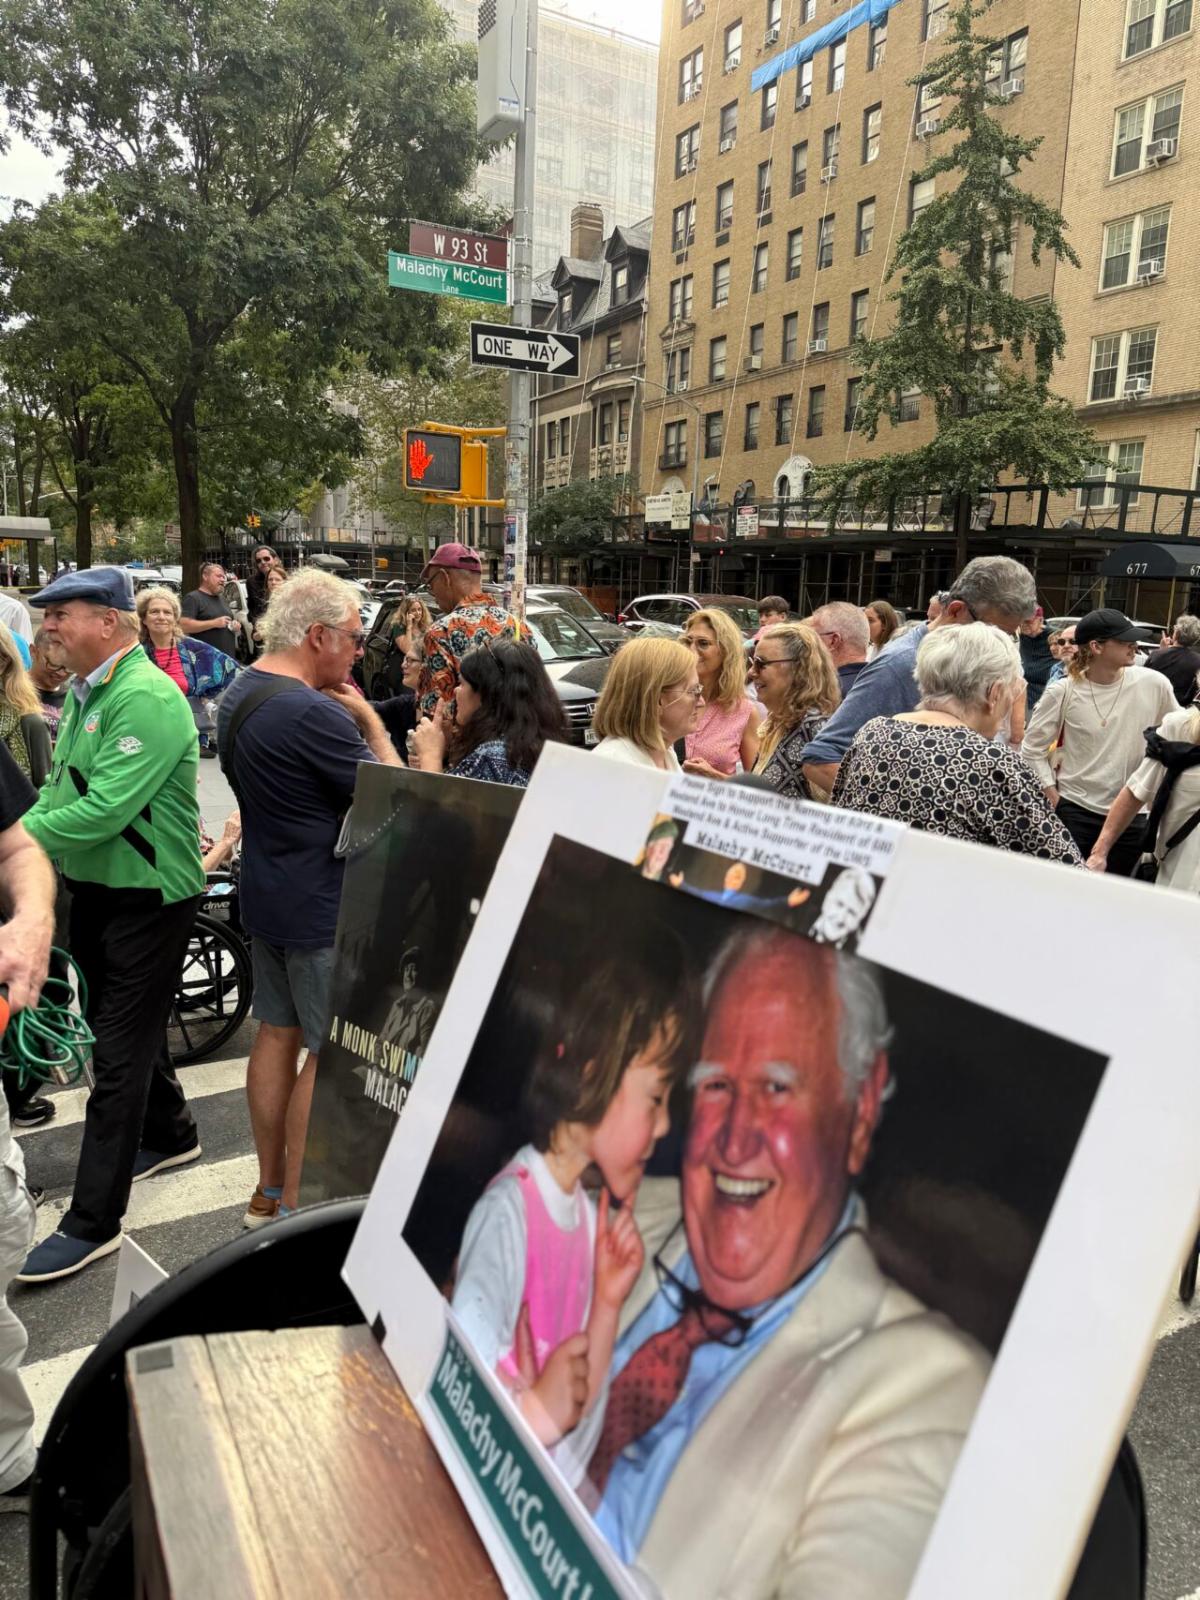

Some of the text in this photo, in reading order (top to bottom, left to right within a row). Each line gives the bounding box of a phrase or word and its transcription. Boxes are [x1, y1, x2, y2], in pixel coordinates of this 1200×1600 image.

[433, 233, 488, 264] W 93 St
[396, 257, 502, 289] Malachy McCourt
[442, 283, 459, 294] Lane
[483, 337, 559, 362] ONE WAY
[1126, 563, 1148, 575] 677
[739, 790, 773, 808] Support
[728, 804, 755, 817] Honor
[756, 808, 780, 828] Long
[783, 814, 806, 831] Time
[810, 823, 857, 844] Resident
[732, 820, 759, 835] Active
[761, 828, 809, 850] Supporter
[810, 843, 824, 853] of
[696, 831, 812, 878] Malachy McCourt
[203, 901, 230, 910] drive
[329, 1015, 422, 1084] A MONK SWIM
[364, 1068, 407, 1115] MALAC
[437, 1351, 582, 1600] Malachy McCourt
